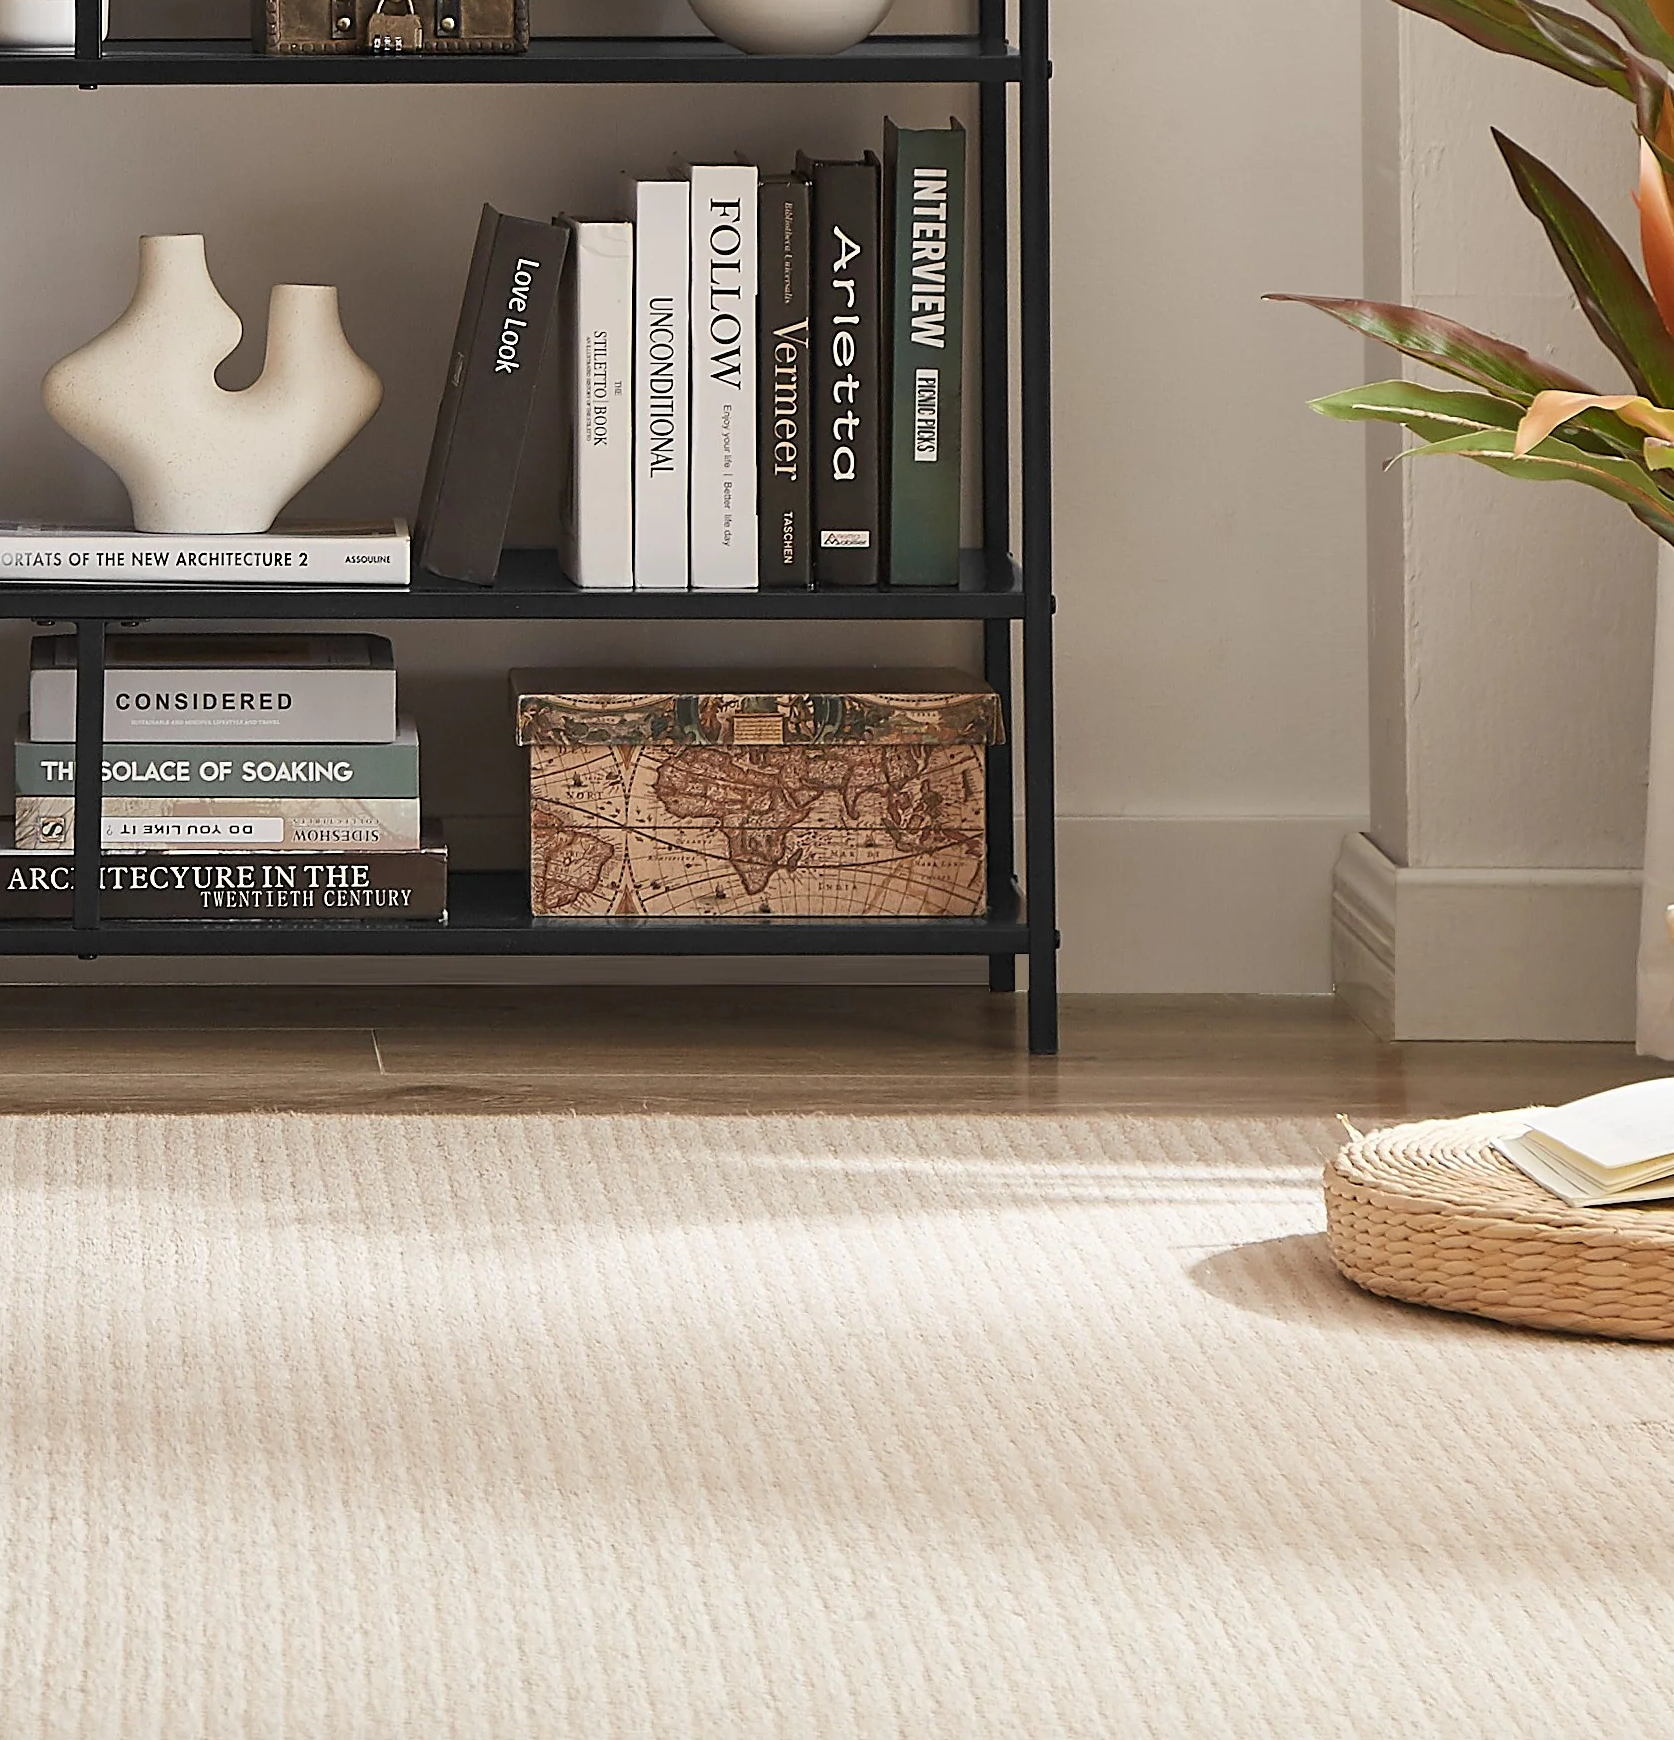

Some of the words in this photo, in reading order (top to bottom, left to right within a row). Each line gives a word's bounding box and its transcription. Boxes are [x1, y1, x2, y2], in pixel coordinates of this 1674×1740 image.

[911, 167, 948, 349] INTERVIEW
[507, 257, 540, 313] Love
[708, 198, 742, 391] FOLLOW
[494, 316, 527, 375] Look
[593, 330, 608, 398] STILETTO
[614, 380, 623, 396] THE
[649, 297, 674, 478] UNCONDITIONAL
[917, 377, 935, 415] PICNIC
[772, 317, 810, 482] Vermeer
[593, 406, 608, 446] BOOK
[721, 404, 732, 430] Enjoy
[721, 432, 731, 452] your
[917, 418, 935, 453] PICKS
[723, 454, 732, 468] life
[723, 481, 732, 509] Better
[723, 514, 733, 527] life
[721, 529, 733, 547] day
[782, 511, 794, 564] TASCHEN
[68, 551, 91, 567] OF
[96, 551, 125, 567] THE
[131, 551, 170, 567] NEW
[175, 551, 292, 567] ARCHITECTURE
[298, 551, 308, 567] 2
[344, 554, 391, 564] ASSOULINE
[115, 693, 292, 710] CONSIDERED
[41, 761, 75, 781] TH
[102, 761, 191, 782] SOLACE
[199, 761, 233, 782] OF
[242, 761, 353, 782] SOAKING
[120, 825, 137, 835] IT
[143, 825, 181, 835] LIKE
[187, 825, 221, 835] YOU
[229, 825, 253, 835] DO
[293, 829, 379, 842] SIDESHOW
[7, 866, 255, 889] ARCITECYURE
[262, 866, 296, 888] IN
[303, 865, 370, 888] THE
[200, 890, 313, 908] TWENTIETH
[323, 889, 412, 907] CENTURY
